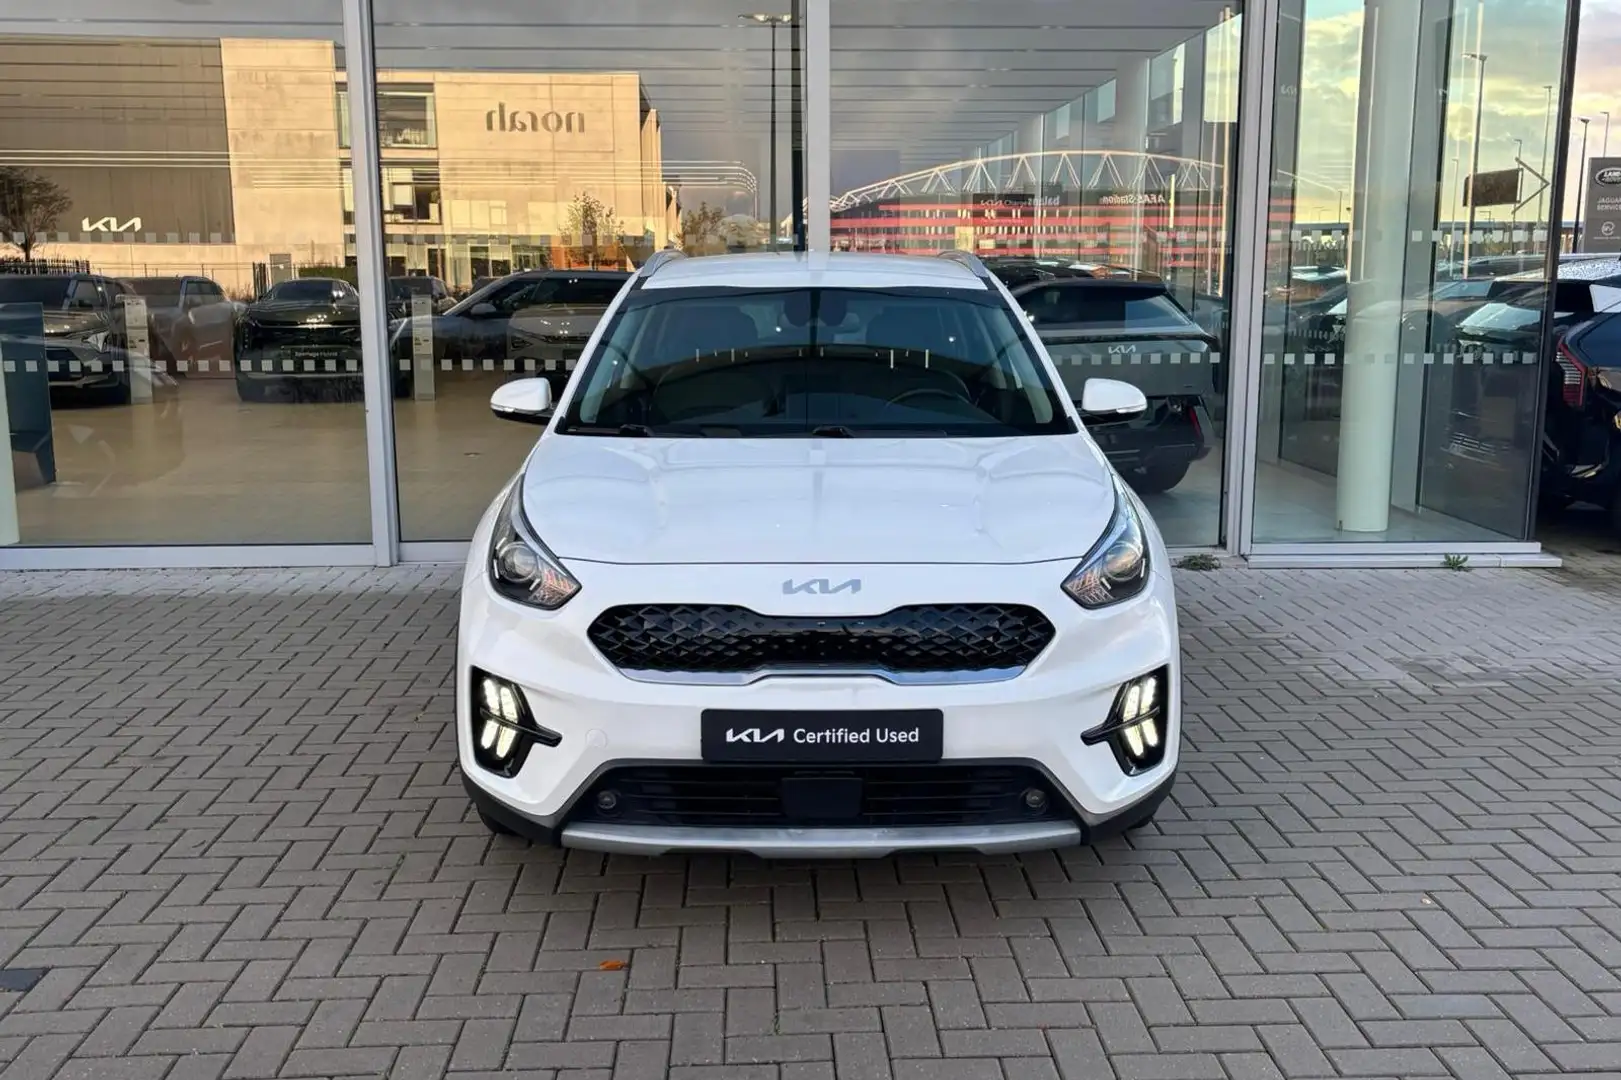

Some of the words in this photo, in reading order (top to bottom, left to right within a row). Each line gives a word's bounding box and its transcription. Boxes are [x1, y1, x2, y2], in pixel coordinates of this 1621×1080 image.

[82, 216, 142, 232] KIA
[782, 578, 862, 595] KIA
[726, 727, 785, 743] KIA
[793, 728, 870, 744] Certified
[876, 727, 919, 743] Used
